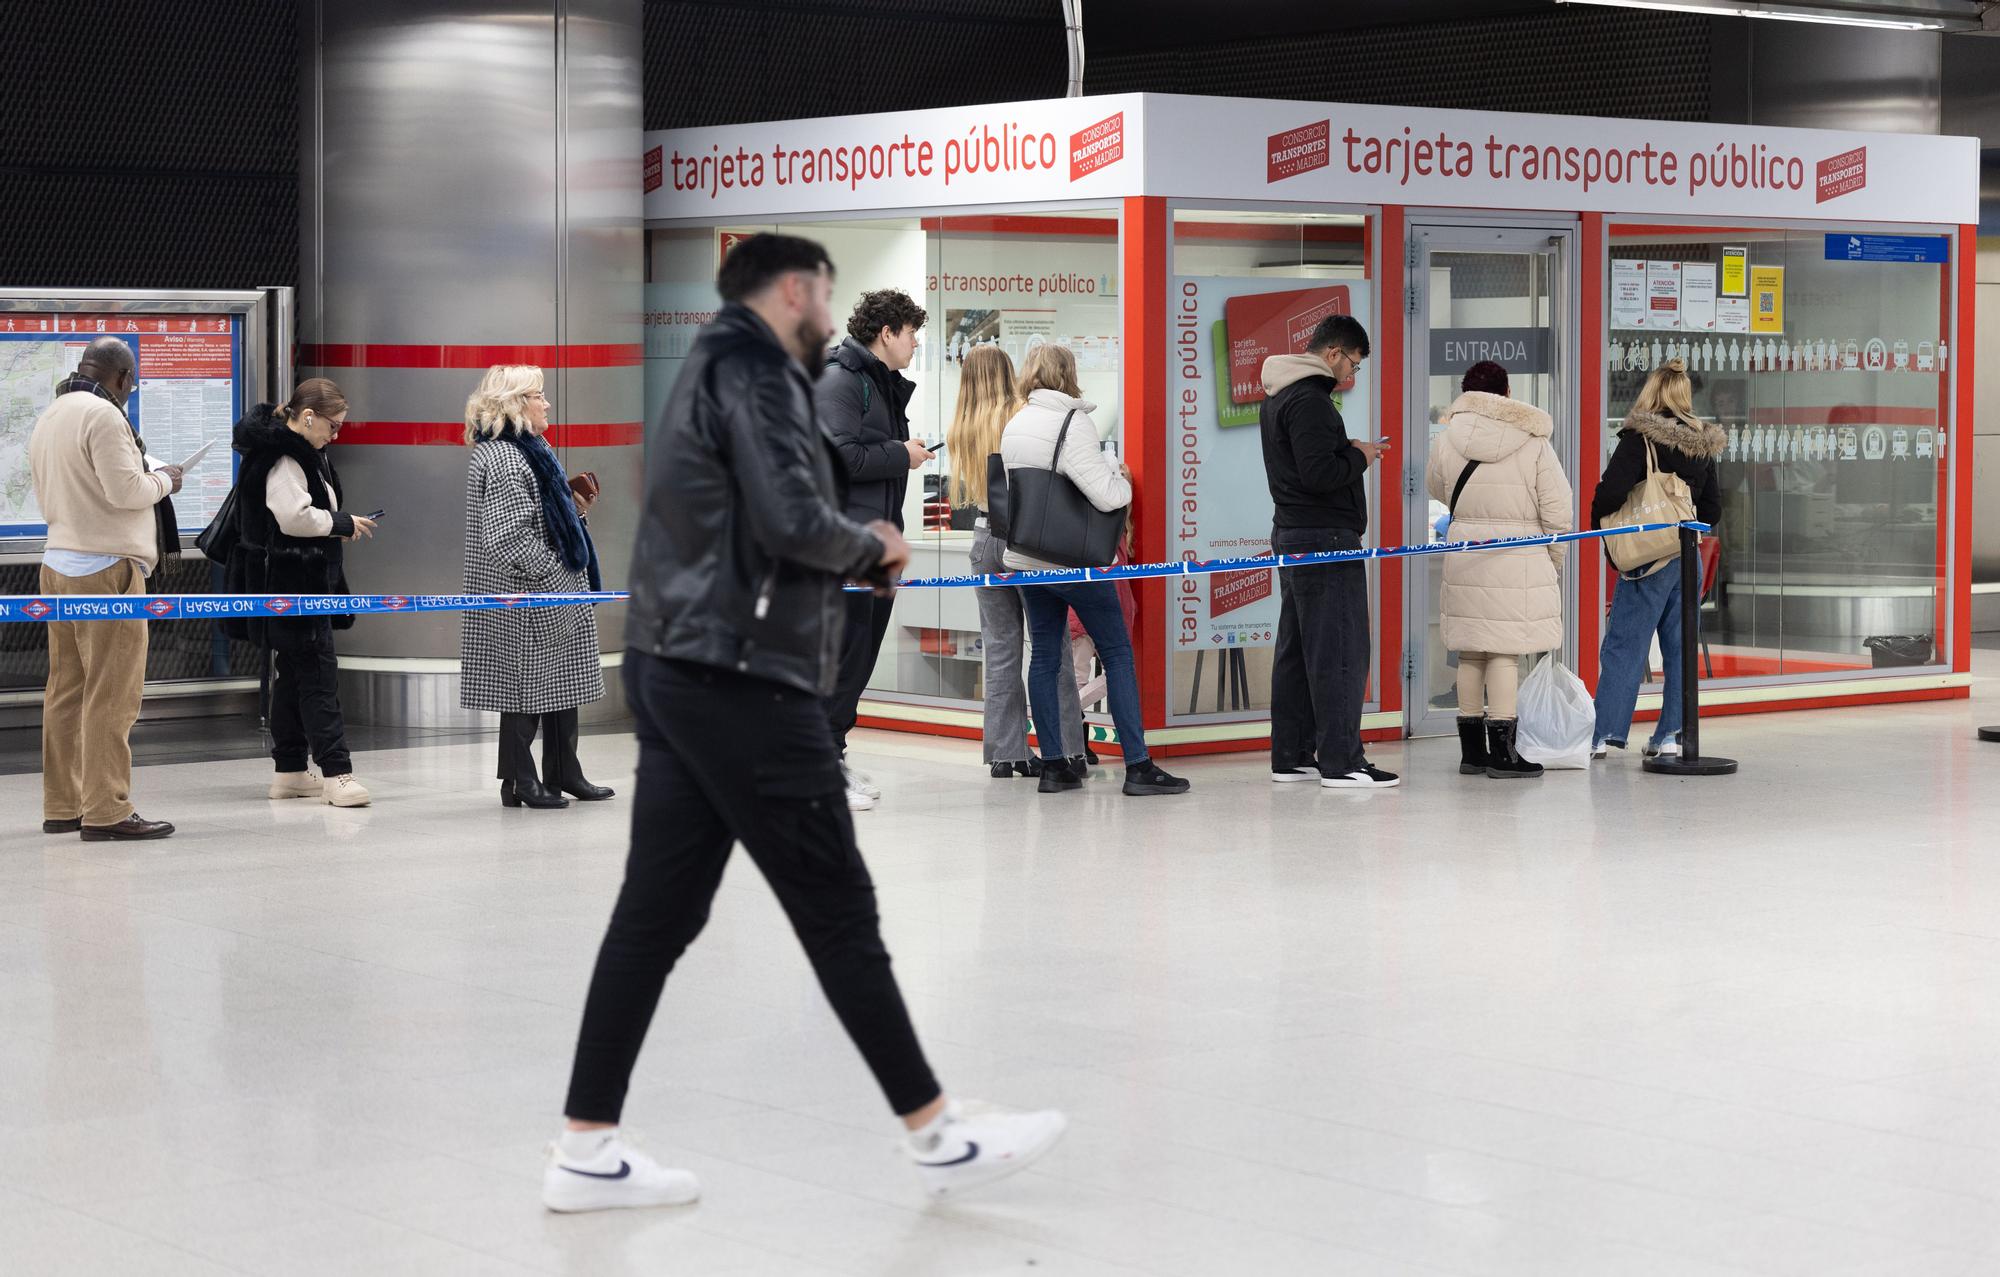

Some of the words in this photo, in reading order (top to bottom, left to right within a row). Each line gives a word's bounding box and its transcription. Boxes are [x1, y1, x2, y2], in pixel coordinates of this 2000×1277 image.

[1081, 117, 1121, 144] CONSORCIO
[1282, 124, 1327, 147] CONSORCIO
[1072, 131, 1121, 163] TRANSPORTES
[1094, 146, 1121, 167] MADRID
[1271, 138, 1326, 164] TRANSPORTES
[671, 144, 764, 199] tarjeta
[773, 134, 933, 191] transporte
[945, 122, 1057, 186] público
[1296, 152, 1326, 171] MADRID
[1344, 128, 1473, 185] tarjeta
[1485, 135, 1678, 193] transporte
[1690, 143, 1804, 196] público
[1828, 151, 1863, 171] CONSORCIO
[1819, 163, 1864, 187] TRANSPORTES
[1839, 175, 1863, 192] MADRID
[943, 273, 1034, 296] transporte
[1039, 272, 1095, 296] público
[644, 309, 673, 328] arjeta
[674, 309, 720, 328] transport
[1178, 282, 1201, 379] público
[1292, 321, 1319, 343] TRANSP
[1234, 338, 1256, 349] tarjeta
[1234, 346, 1268, 357] transporte
[1445, 341, 1527, 361] ENTRADA
[1235, 356, 1257, 368] público
[1179, 389, 1201, 541] transporte
[1209, 539, 1238, 548] unimos
[1239, 537, 1272, 546] Personas
[920, 576, 938, 585] NO
[941, 574, 981, 583] PASAR
[1022, 570, 1040, 578] NO
[1214, 569, 1269, 599] TRANSPORTES
[350, 597, 371, 608] NO
[1178, 549, 1201, 646] tarjea
[1239, 582, 1269, 604] MADRID
[64, 603, 109, 615] PASAR
[112, 602, 133, 614] NO
[186, 601, 229, 613] PASAR
[233, 600, 254, 611] NO
[304, 598, 347, 610] PASAR
